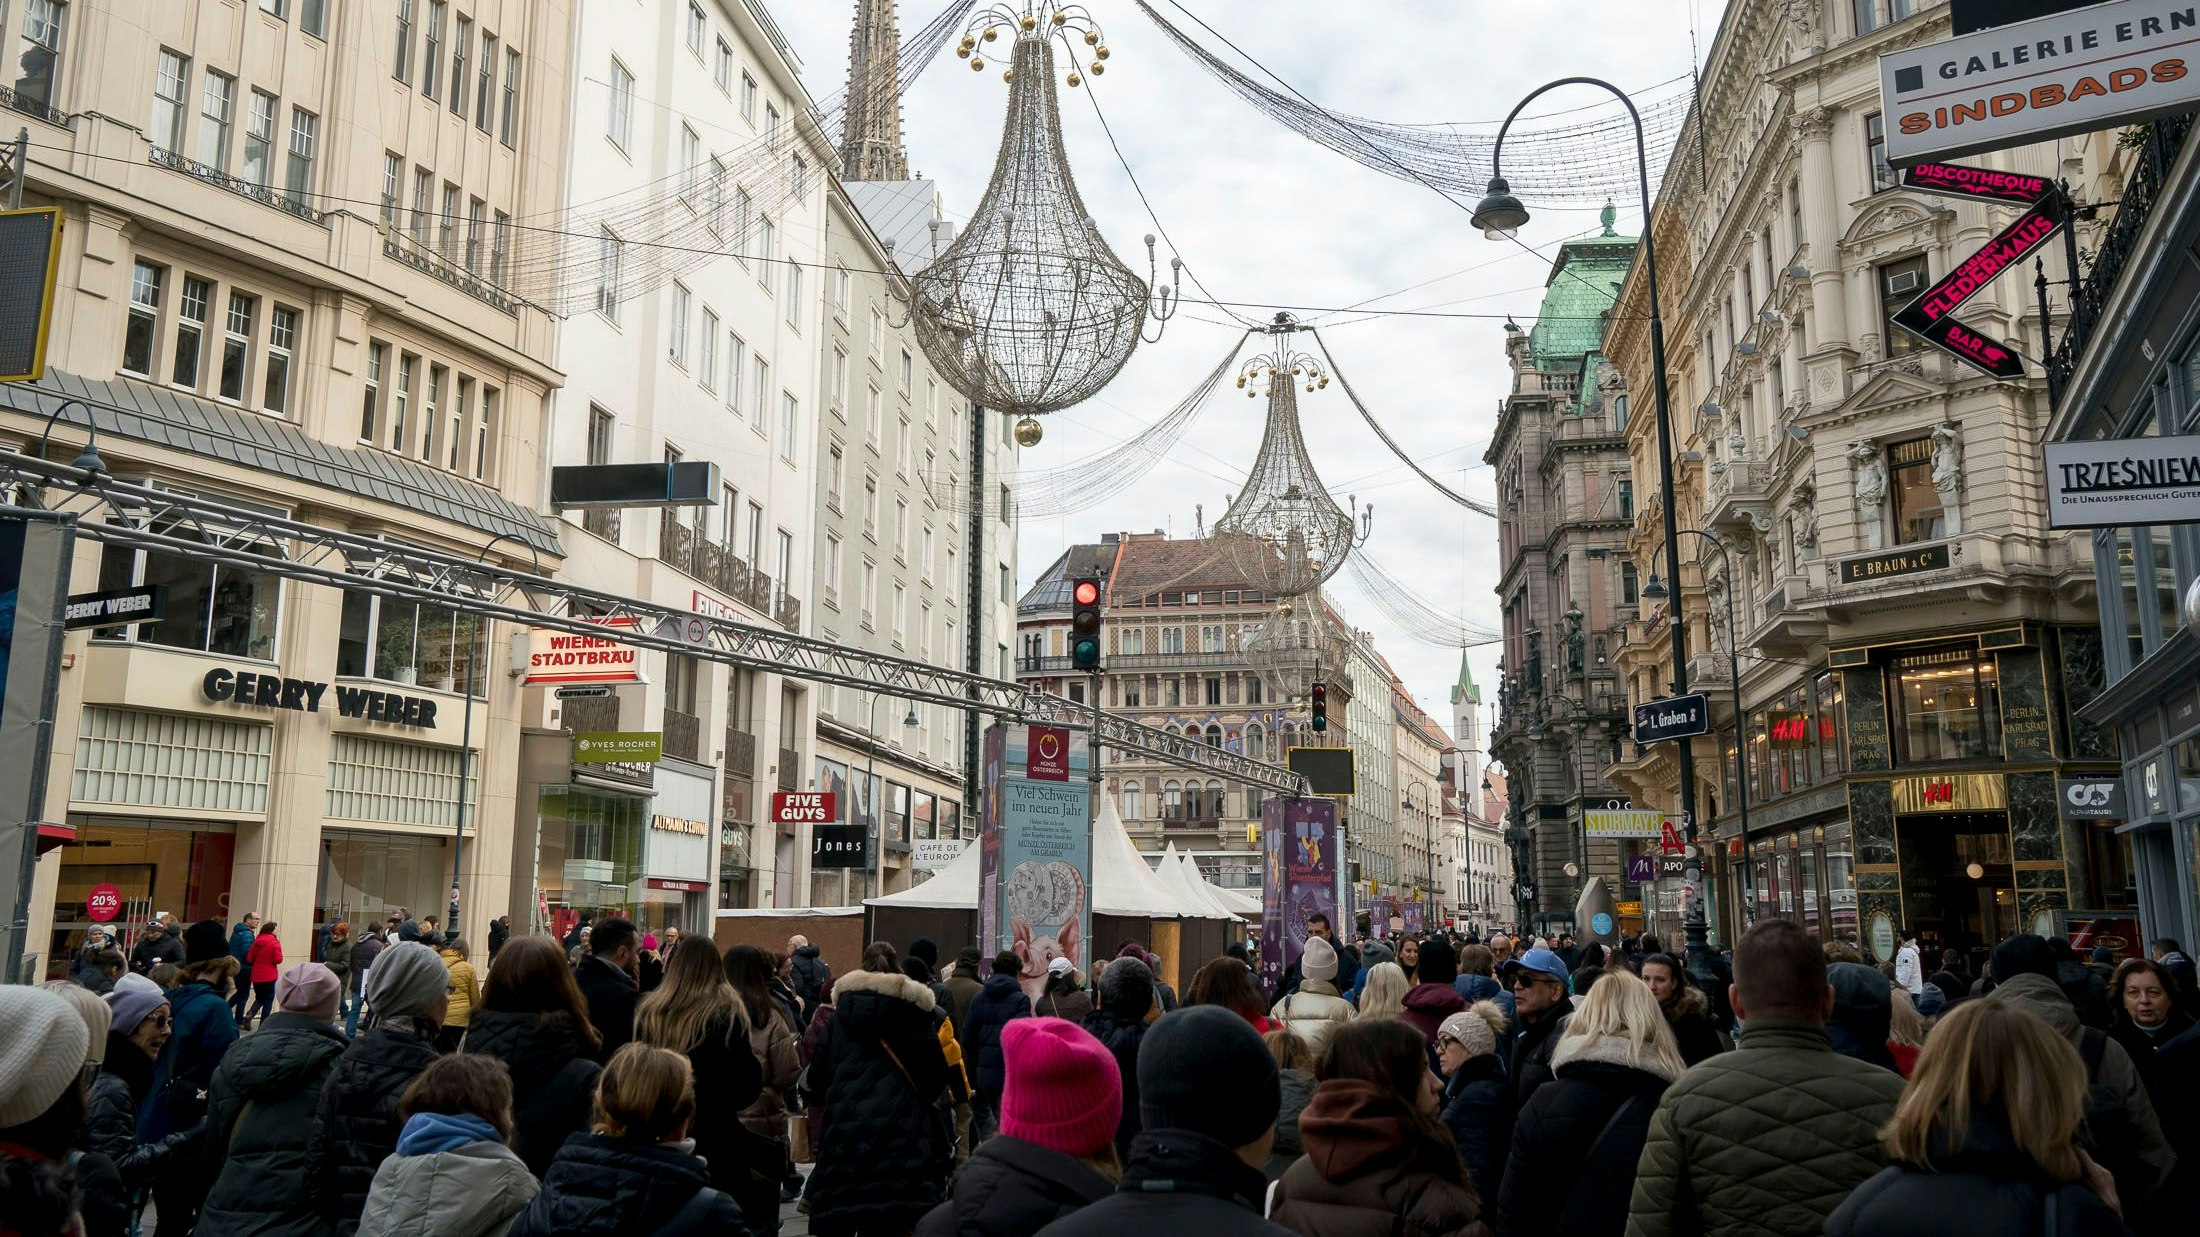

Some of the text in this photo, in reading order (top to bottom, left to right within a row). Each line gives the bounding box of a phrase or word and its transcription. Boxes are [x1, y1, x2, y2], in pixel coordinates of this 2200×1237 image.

[1939, 30, 2098, 79] GALERIE
[1899, 58, 2188, 135] SINDBADS
[1914, 164, 2044, 193] DISCOTHEQUE
[1956, 240, 2001, 276] CABARET
[1922, 215, 2054, 321] FLEDERMAUS
[1947, 326, 1983, 352] BAR
[1853, 565, 1864, 577] E.
[1867, 557, 1907, 575] BRAUN
[1912, 560, 1917, 568] &
[65, 594, 151, 619] GERRY WEBER
[531, 650, 635, 667] STADTBRÄU
[203, 667, 437, 729] GERRY WEBER
[1650, 714, 1658, 729] 1.
[1659, 710, 1687, 727] Graben
[2010, 706, 2039, 719] BERLIN
[1854, 721, 1879, 731] BERLIN
[2003, 721, 2048, 733] KARLSBAD
[2015, 737, 2040, 749] PRAG
[1858, 749, 1880, 759] PRAG
[1033, 766, 1063, 774] ÖSTERREICH
[1040, 760, 1056, 768] MÜNZE
[785, 794, 822, 807] FIVE
[1015, 785, 1078, 802] Viel Schwein
[780, 807, 826, 820] GUYS
[1012, 799, 1082, 818] im neuen Jahr
[722, 829, 743, 846] GUYS
[814, 837, 861, 854] Jones
[1018, 839, 1075, 850] MÜNZE ÖSTERREICH
[920, 844, 958, 852] CAFÉ DE
[1041, 849, 1063, 857] GRABEN
[1288, 863, 1312, 872] Wiener
[1289, 872, 1332, 883] Silvesterpfad
